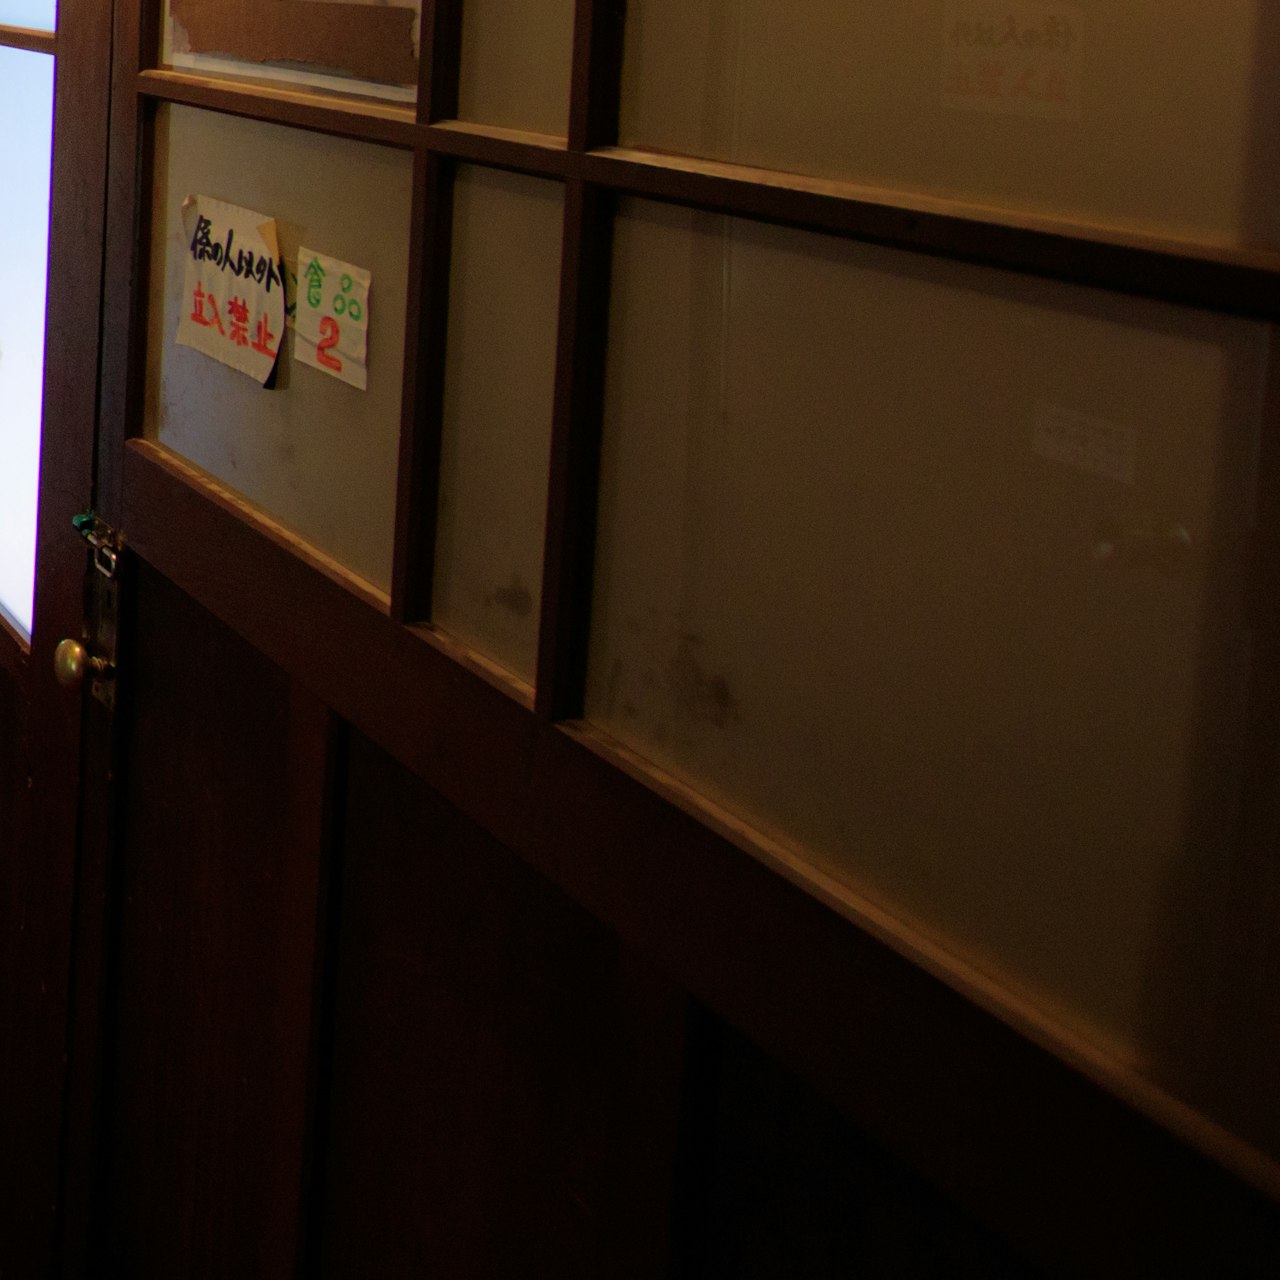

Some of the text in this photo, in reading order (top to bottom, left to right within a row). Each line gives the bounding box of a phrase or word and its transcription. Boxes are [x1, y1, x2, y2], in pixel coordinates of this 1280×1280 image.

[190, 214, 281, 293] 係の人以外
[304, 256, 362, 322] 食品
[190, 281, 277, 360] 立入禁止
[316, 316, 343, 372] 2
